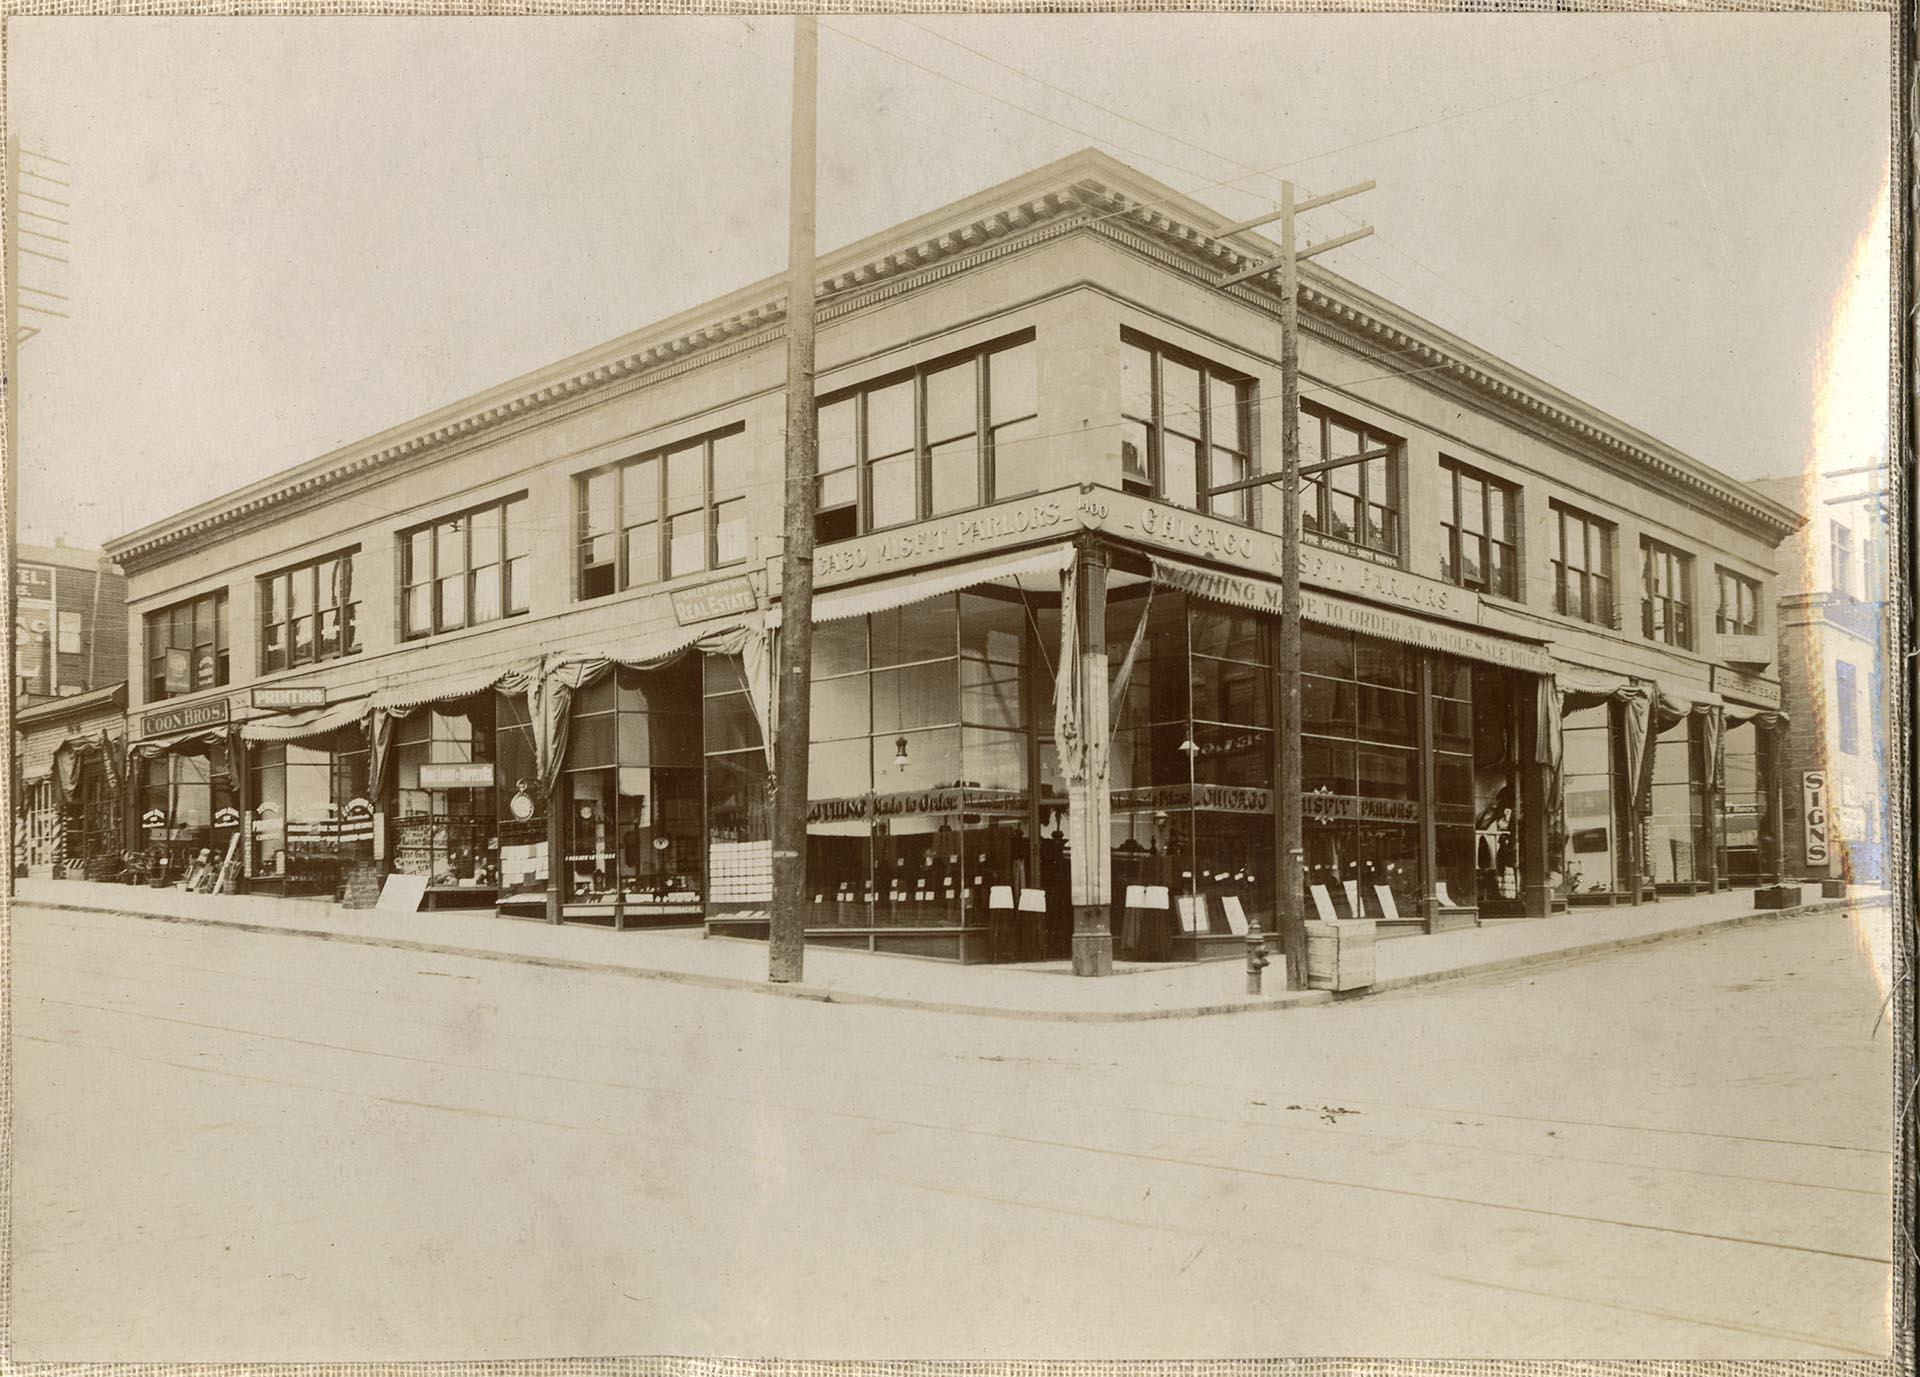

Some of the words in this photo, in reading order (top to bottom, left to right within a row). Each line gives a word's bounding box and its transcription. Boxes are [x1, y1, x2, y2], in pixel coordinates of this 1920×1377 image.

[876, 529, 949, 565] MISFIT
[1140, 507, 1254, 560] CHICAGO
[677, 602, 711, 619] REAL
[707, 591, 753, 615] ESTATE
[1324, 602, 1344, 621] TO
[1349, 608, 1399, 636] ORDER
[1406, 624, 1424, 640] AT
[1428, 629, 1506, 661] WHOLESALE
[255, 689, 323, 705] PRINTING
[146, 713, 182, 732] COON
[184, 708, 226, 726] BROS.
[1805, 774, 1827, 860] SIGNS
